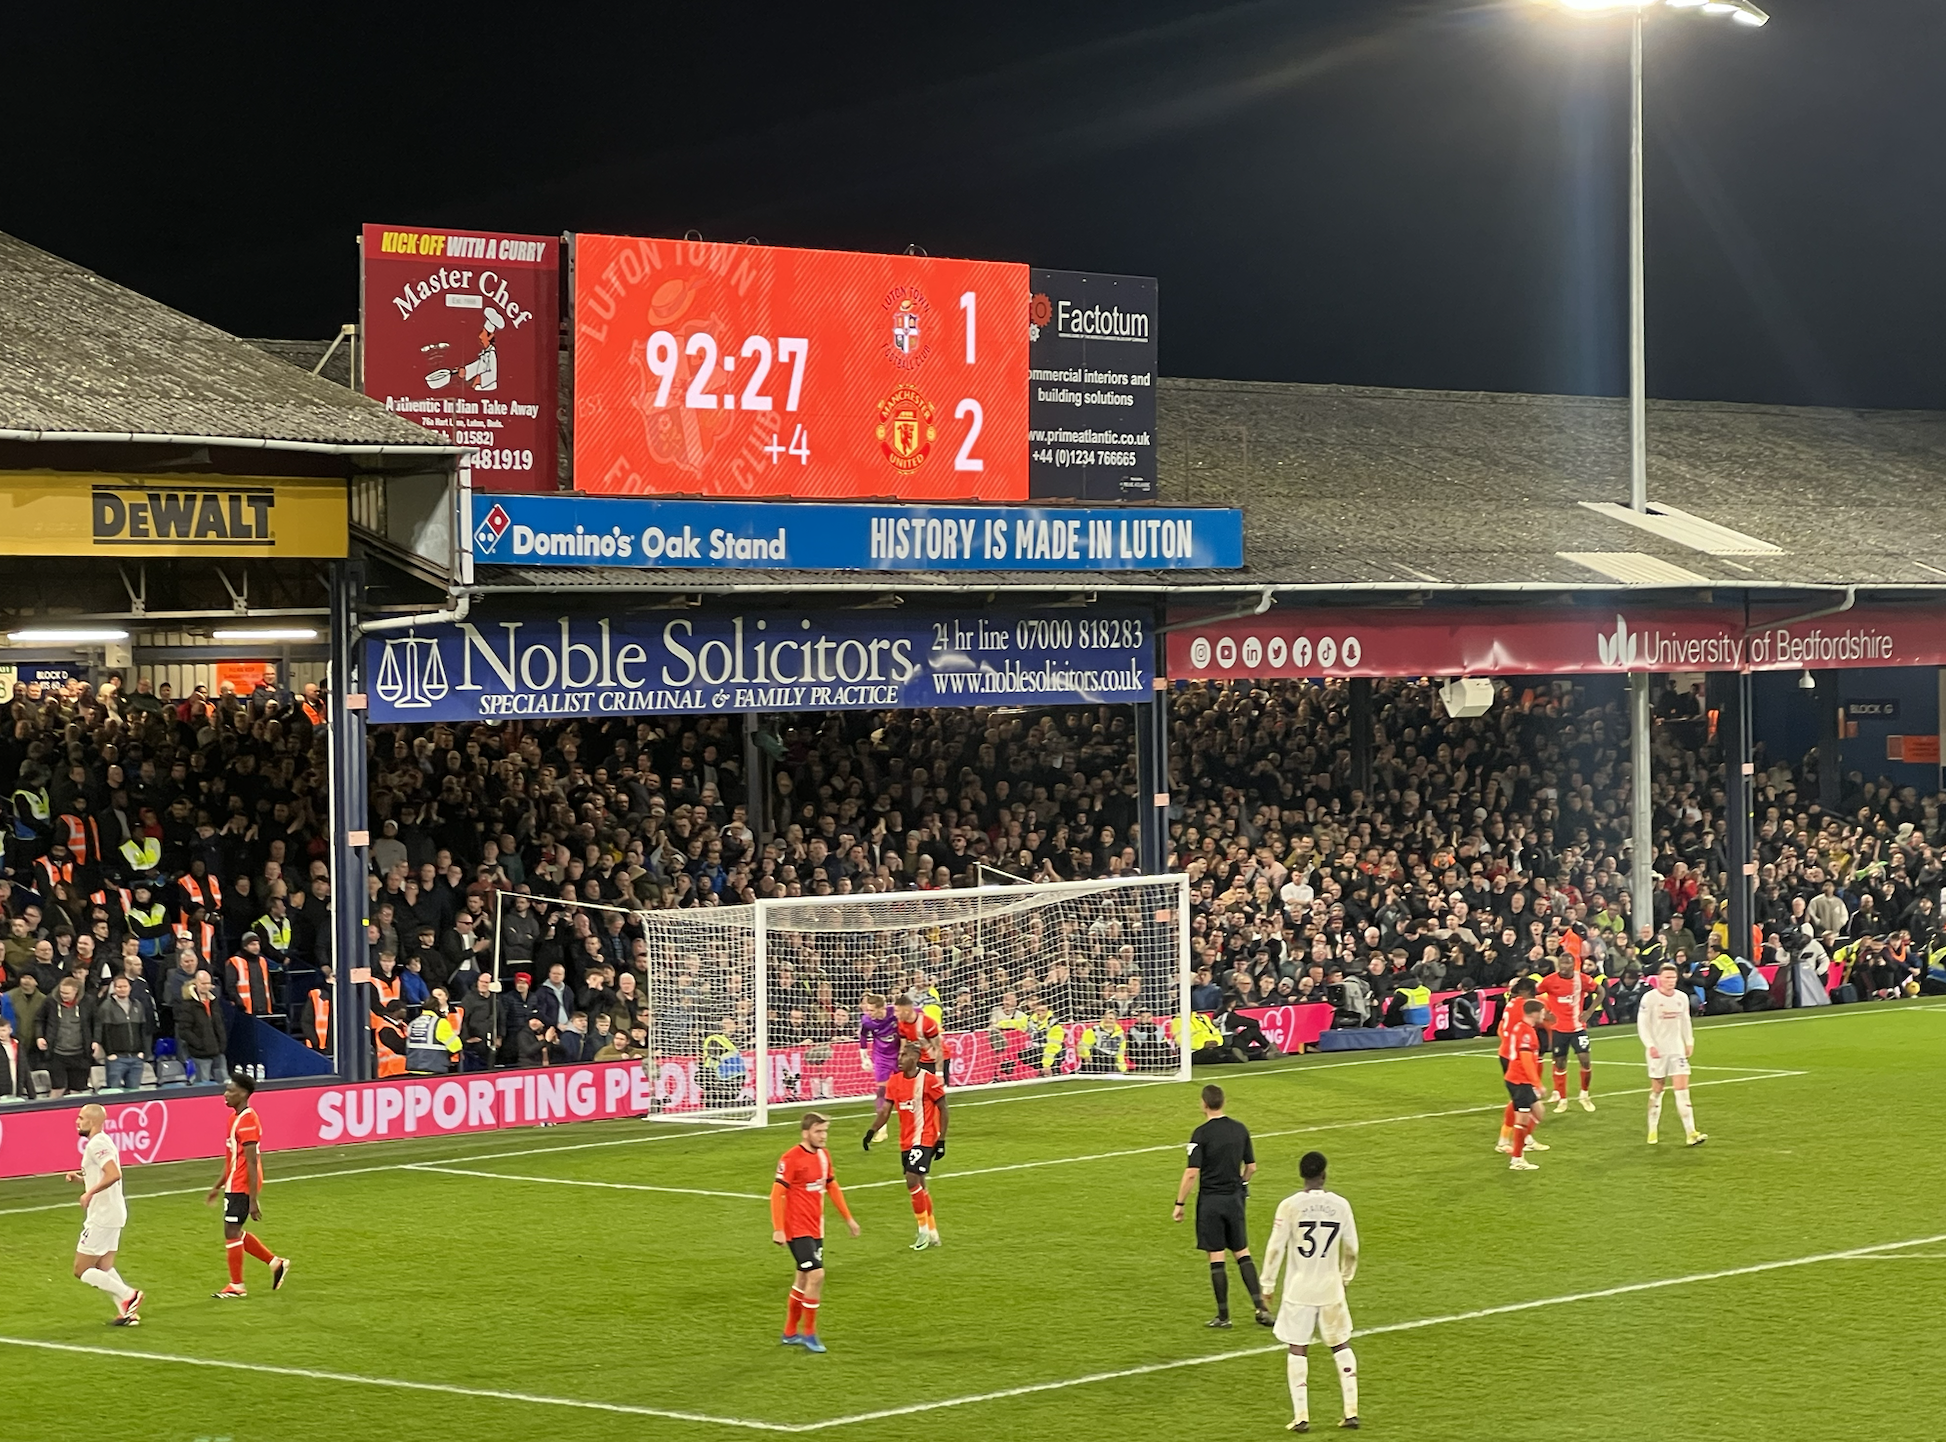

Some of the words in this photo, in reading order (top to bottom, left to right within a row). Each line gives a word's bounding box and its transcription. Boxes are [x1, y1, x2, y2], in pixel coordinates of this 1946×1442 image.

[381, 231, 418, 254] KICK
[419, 234, 446, 256] OFF
[446, 236, 486, 259] WITH
[485, 239, 497, 260] A
[499, 240, 546, 262] CURRY
[392, 267, 473, 320] Master
[478, 271, 532, 329] Chef
[959, 291, 976, 364] 1
[1057, 300, 1149, 337] Factotum
[646, 330, 809, 412] 92:27
[1028, 368, 1082, 382] ommercial
[1084, 369, 1129, 385] interiors
[1130, 372, 1151, 386] and
[443, 398, 478, 414] Indian
[481, 399, 508, 415] Take
[509, 400, 539, 419] Away
[881, 390, 931, 420] MANCHESTER
[1037, 387, 1082, 407] building
[1084, 390, 1134, 406] solutions
[456, 430, 494, 446] 01582)
[764, 423, 811, 465] +4
[953, 397, 984, 471] 2
[1028, 428, 1151, 445] ww.primeatlantic.co.uk
[471, 448, 533, 471] 481919
[889, 453, 924, 469] UNITED
[1032, 448, 1053, 463] +44
[1055, 449, 1095, 467] (0)1234
[1097, 450, 1136, 466] 766665
[512, 525, 634, 558] Domino's
[641, 526, 702, 559] Oak
[709, 527, 786, 560] Stand
[869, 517, 976, 560] HISTORY
[983, 519, 1008, 560] IS
[1014, 519, 1080, 560] MADE
[1088, 519, 1113, 560] IN
[1119, 519, 1193, 559] LUTON
[932, 622, 950, 651] 24
[954, 619, 973, 650] hr
[978, 619, 1009, 650] line
[1015, 620, 1076, 650] 07000
[1078, 619, 1143, 649] 818283
[1643, 629, 1744, 669] University
[1751, 630, 1771, 662] of
[1777, 628, 1893, 662] Bedfordshire
[454, 616, 647, 693] Noble
[661, 616, 913, 688] Solicitors
[931, 657, 1144, 695] www.noblesolicitors.co.uk
[478, 692, 595, 715] SPECIALIST
[598, 688, 706, 711] CRIMINAL
[711, 687, 731, 709] &
[733, 685, 803, 709] FAMILY
[809, 685, 899, 705] PRACTICE
[1850, 704, 1881, 714] BLOCK
[1577, 1035, 1590, 1049] 15
[318, 1069, 597, 1141] SUPPORTING
[1297, 1221, 1341, 1258] 37
